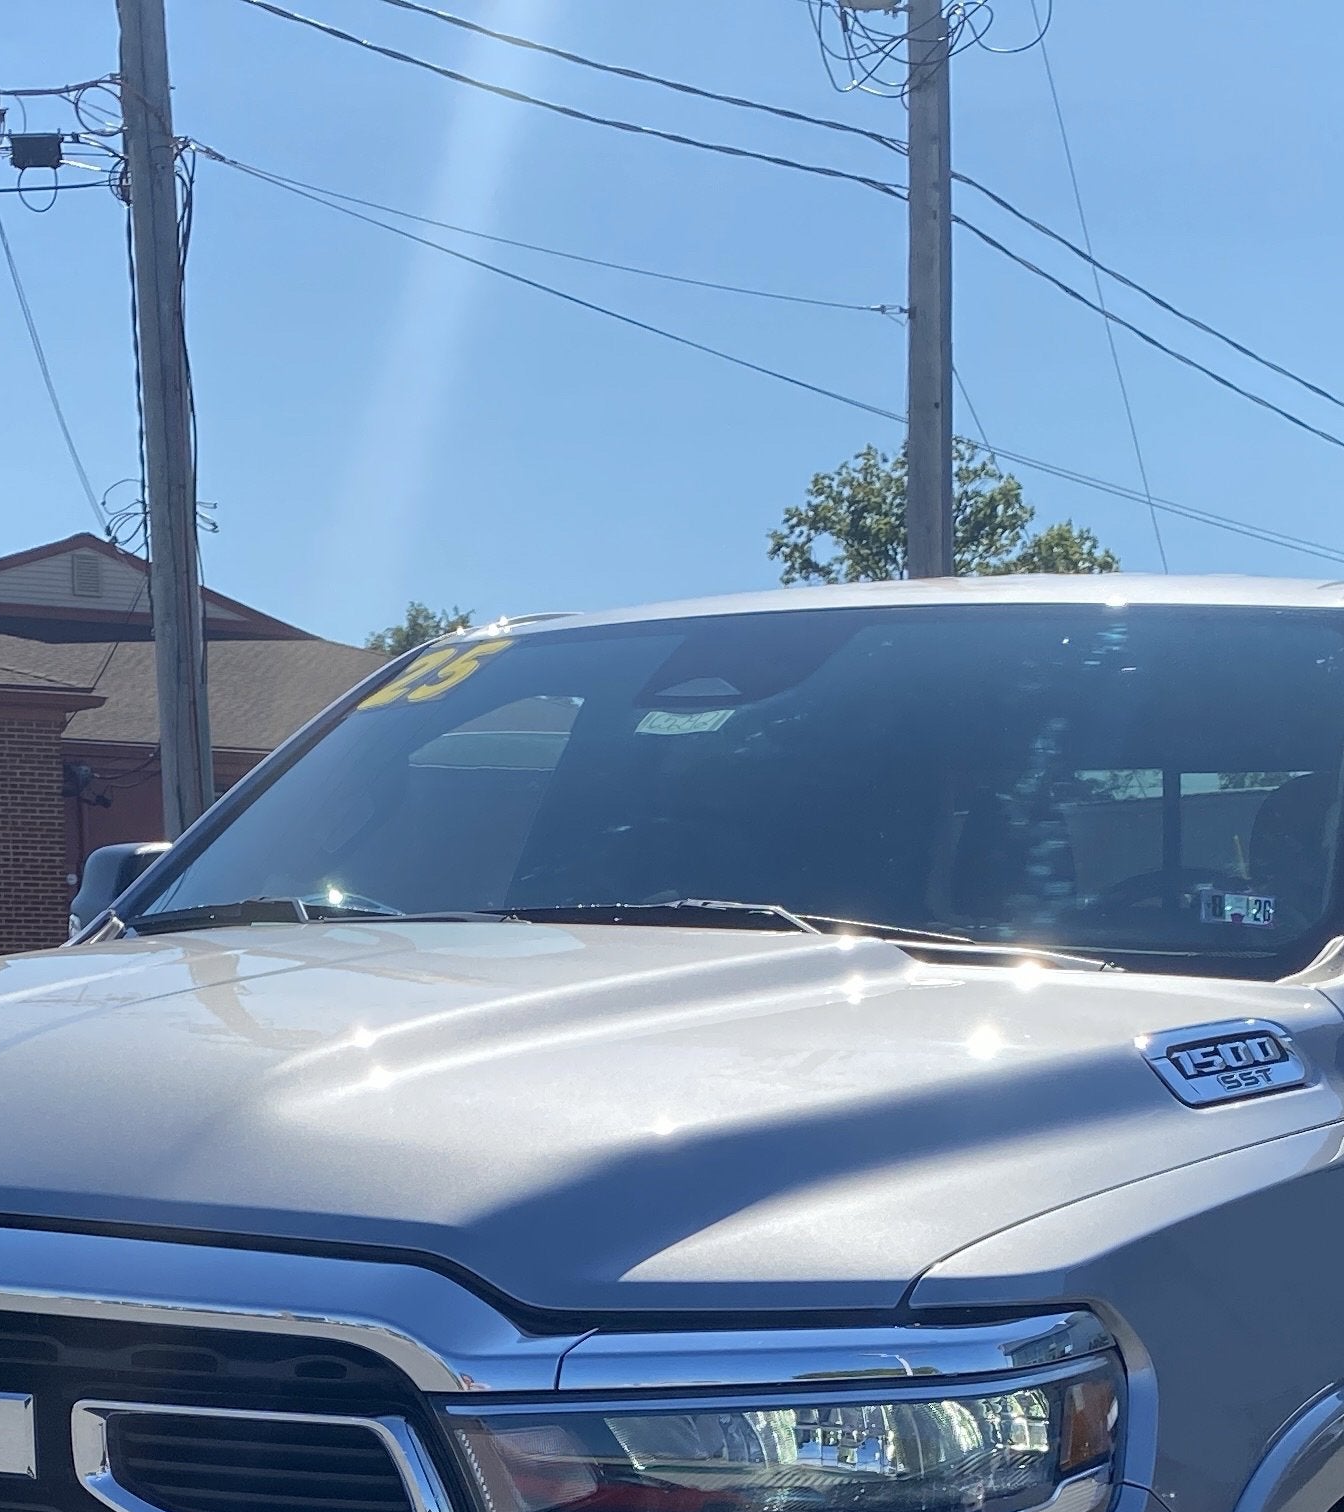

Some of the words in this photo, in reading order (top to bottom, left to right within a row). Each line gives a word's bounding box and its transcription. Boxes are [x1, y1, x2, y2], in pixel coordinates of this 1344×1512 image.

[356, 638, 515, 712] 25
[1170, 1036, 1282, 1077] 1500
[1217, 1066, 1273, 1092] SST
